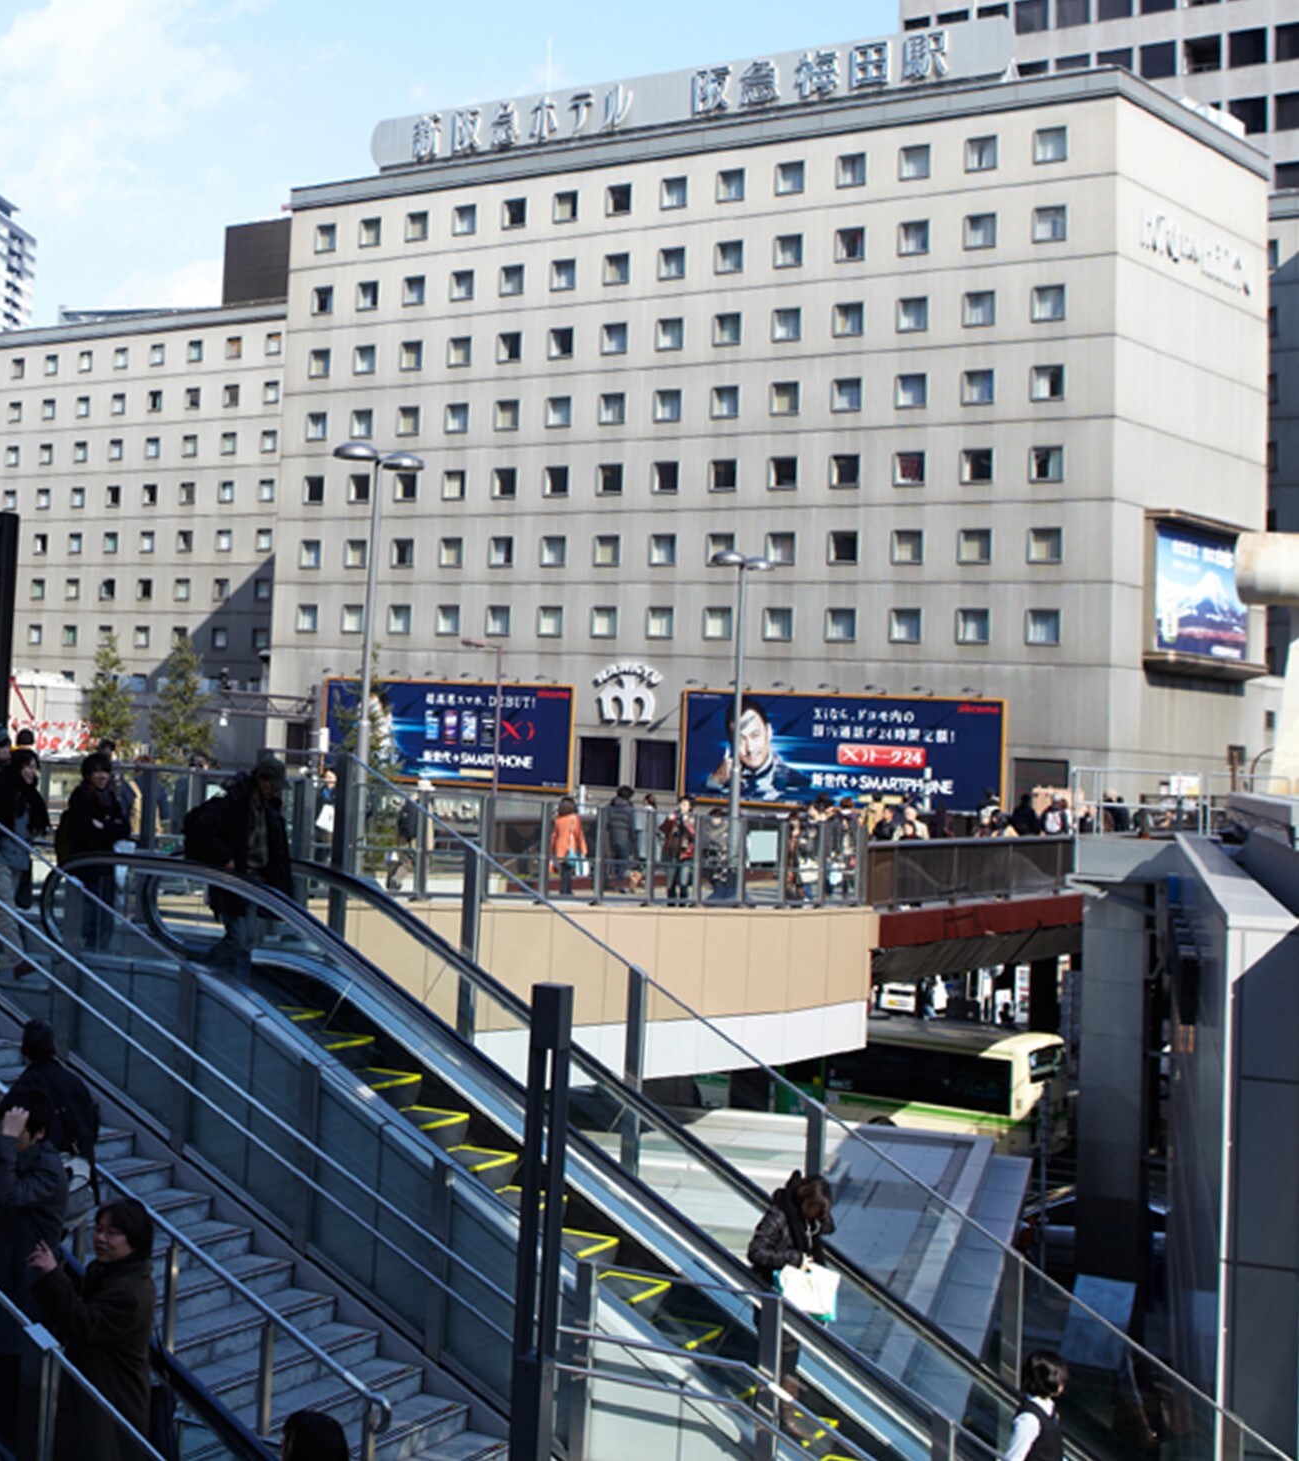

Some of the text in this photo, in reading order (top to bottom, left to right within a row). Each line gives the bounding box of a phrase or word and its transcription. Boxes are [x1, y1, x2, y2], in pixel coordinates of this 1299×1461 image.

[692, 30, 949, 117] 阪急梅田駅
[412, 84, 635, 164] 新阪急ホテル
[957, 703, 1000, 715] docomo
[810, 772, 848, 789] 新世代
